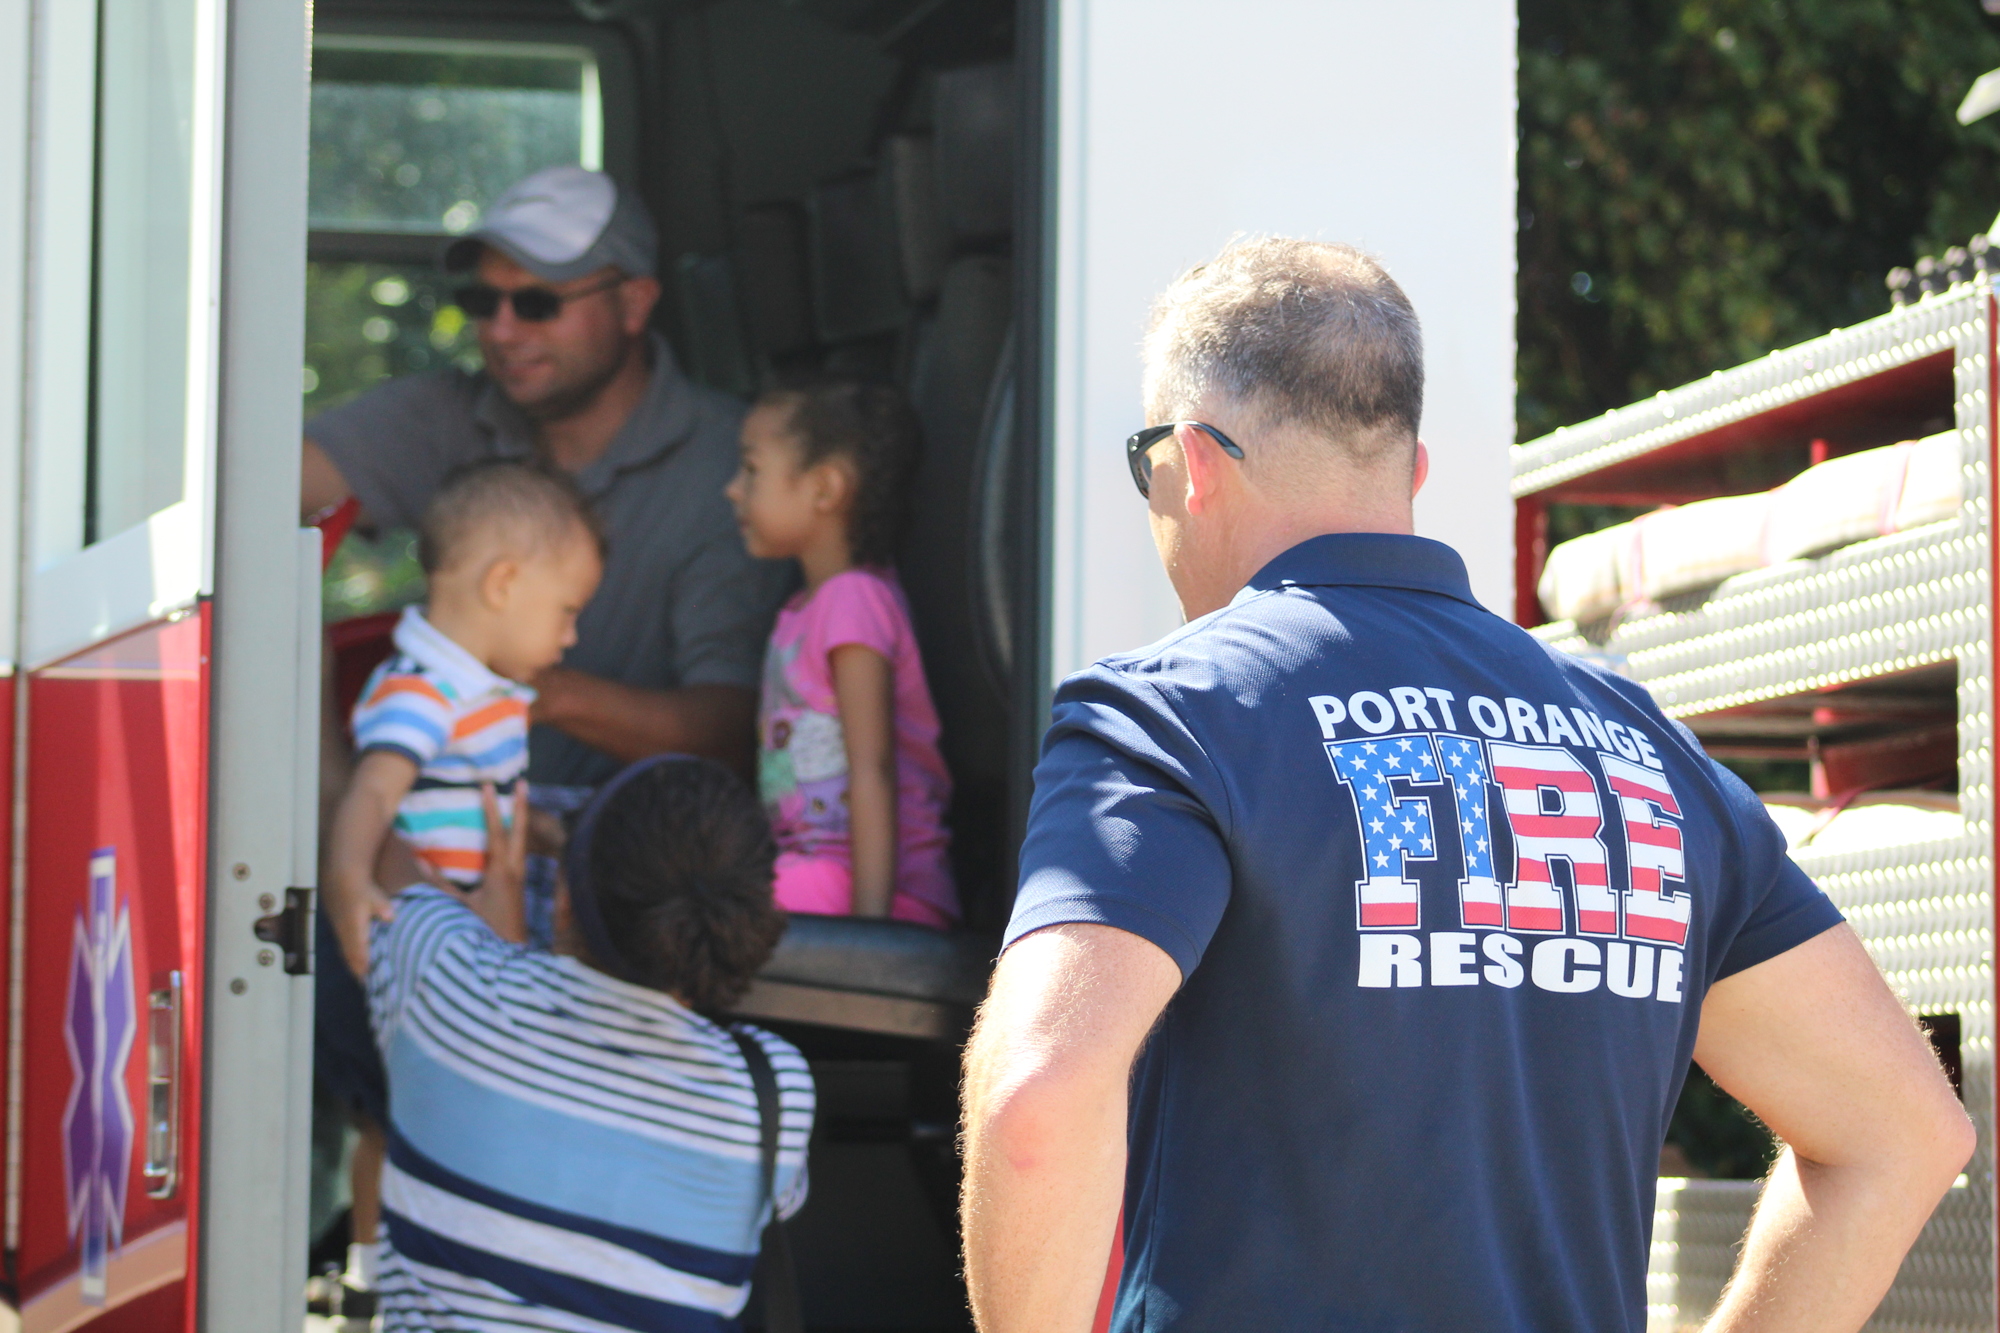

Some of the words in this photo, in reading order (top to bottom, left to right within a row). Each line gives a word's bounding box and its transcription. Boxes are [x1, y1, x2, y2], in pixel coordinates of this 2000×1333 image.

[1308, 686, 1457, 739] PORT
[1467, 695, 1663, 770] ORANGE
[1323, 731, 1692, 949] FIRE
[1357, 931, 1684, 1003] RESCUE
